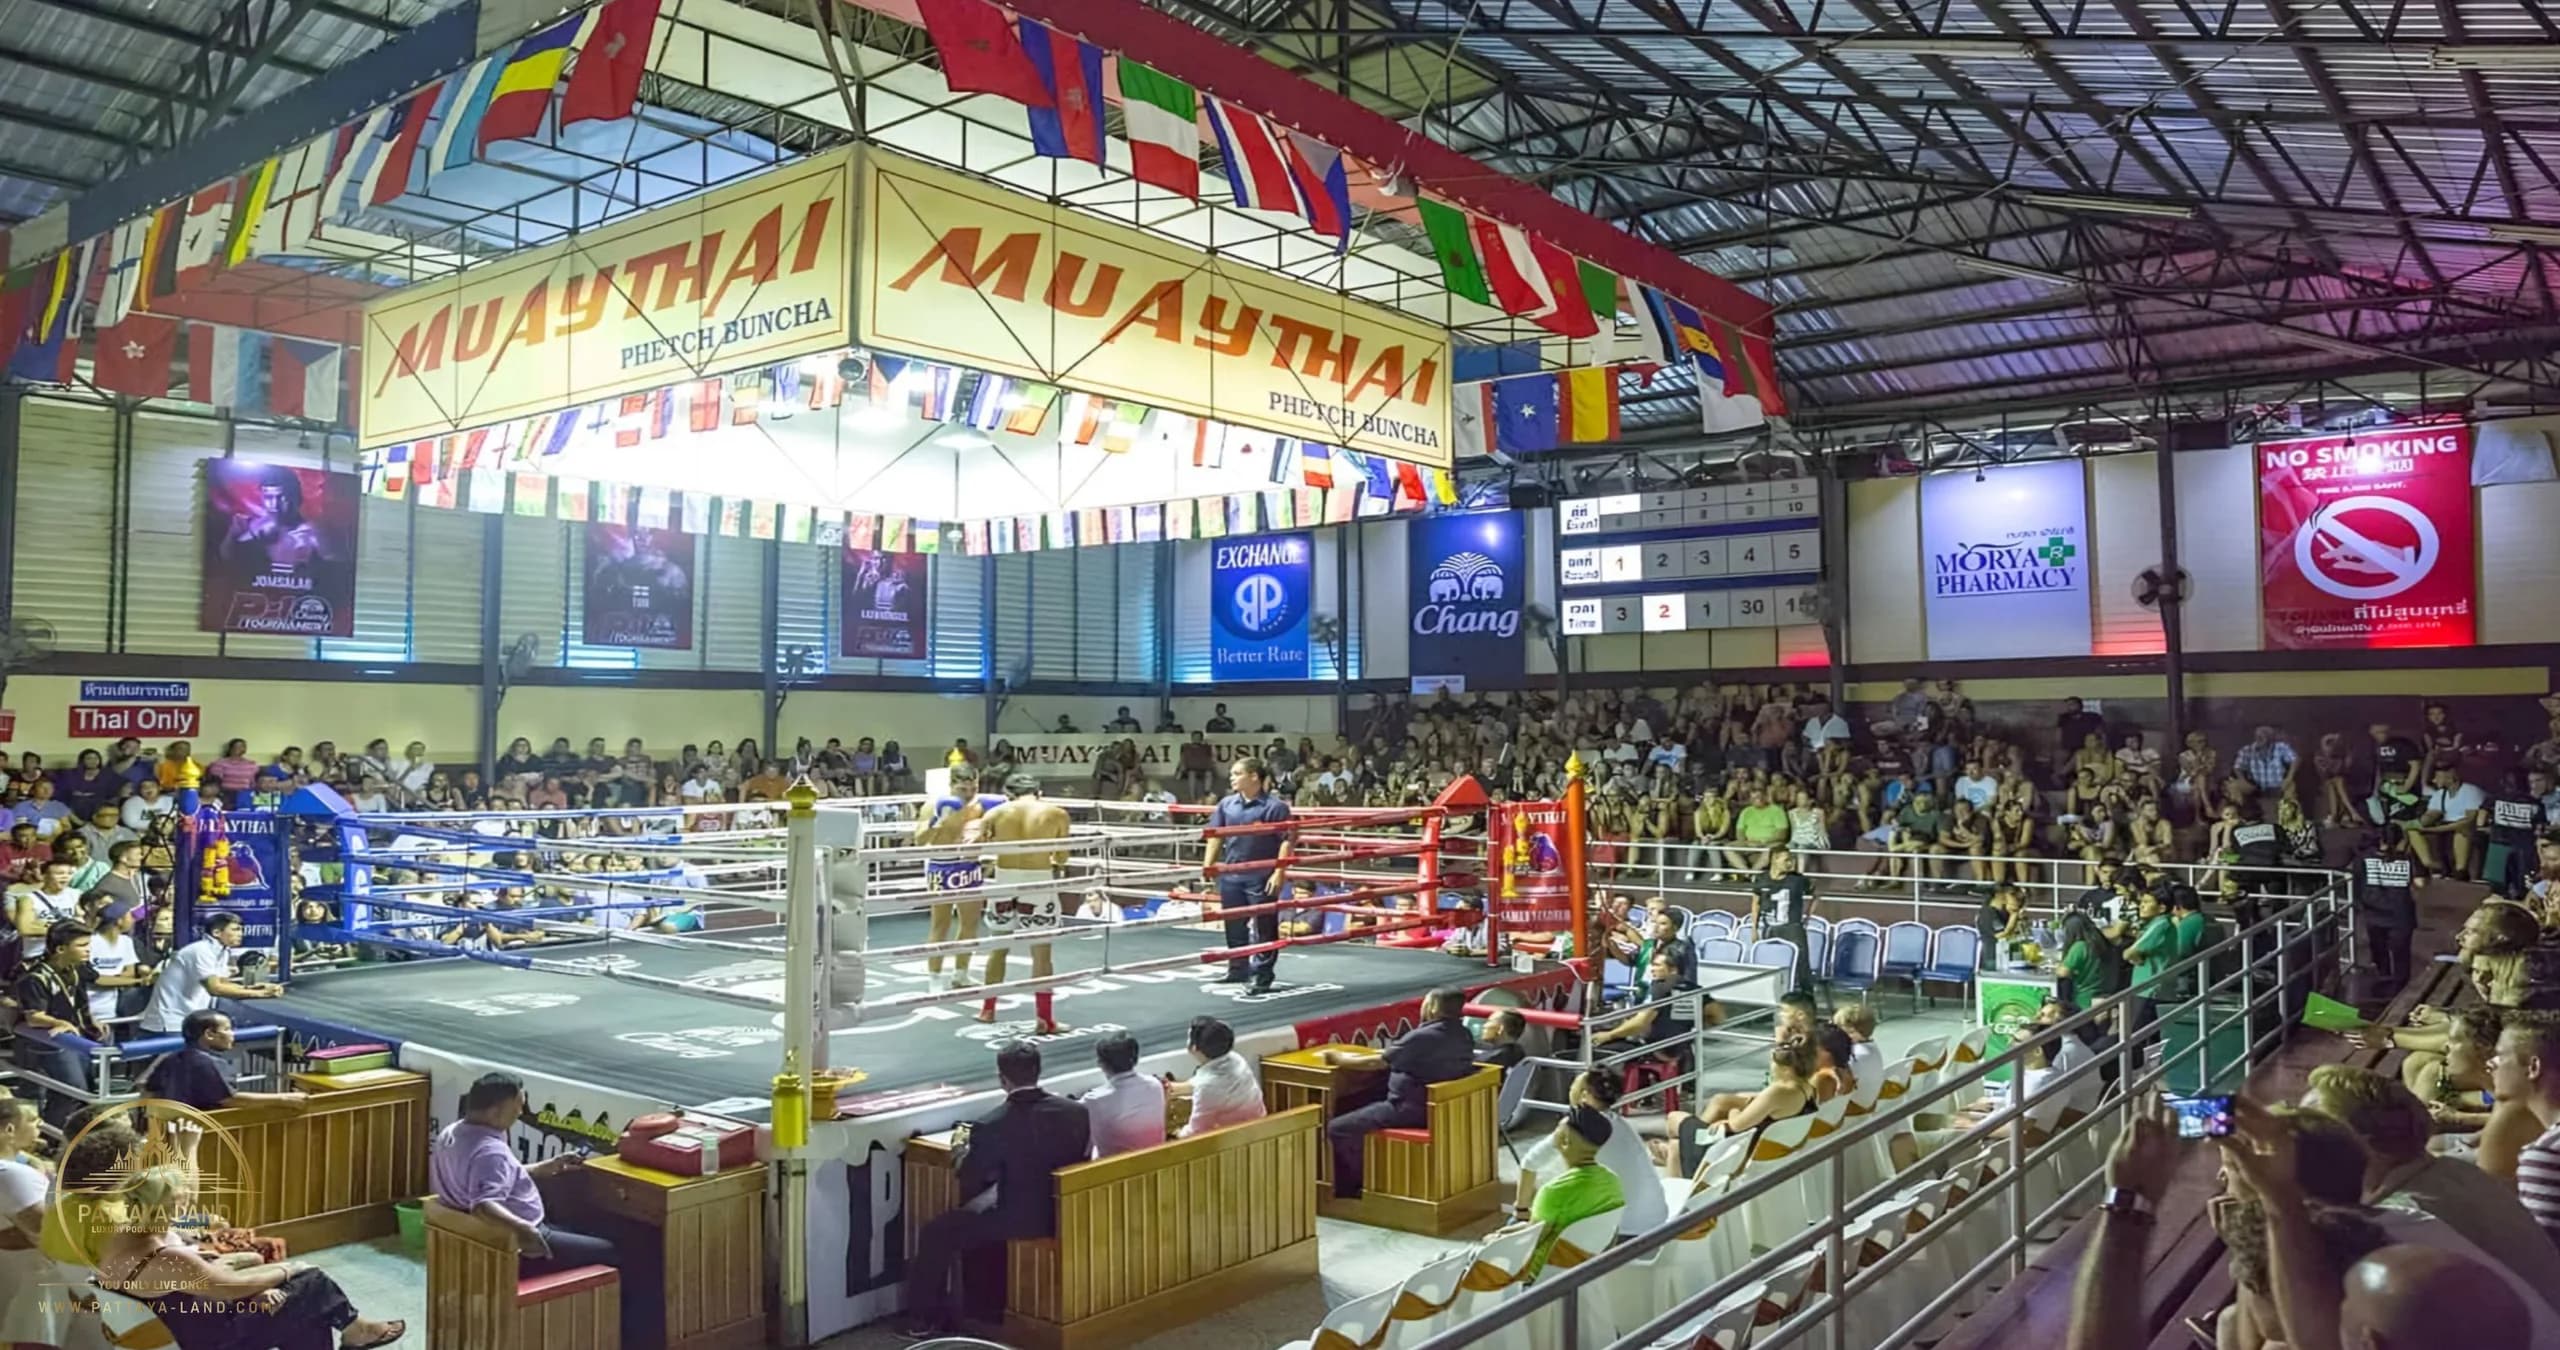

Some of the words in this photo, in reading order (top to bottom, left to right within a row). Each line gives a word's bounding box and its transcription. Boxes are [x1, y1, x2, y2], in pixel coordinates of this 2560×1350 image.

[621, 326, 714, 369] PHETCH
[722, 297, 832, 344] BUNCHA
[1269, 391, 1355, 429] PHETCH
[1362, 412, 1439, 448] BUNCHA
[2267, 449, 2309, 468] NO
[2316, 436, 2457, 463] SMOKING
[1789, 502, 1804, 512] 10
[1616, 557, 1624, 572] 1
[1657, 554, 1669, 568] 2
[1699, 550, 1710, 565] 3
[1744, 547, 1755, 562] 4
[1789, 544, 1800, 560] 5
[1936, 547, 2040, 575] MORYA
[1937, 567, 2076, 595] PHARMACY
[1413, 604, 1519, 637] Chang
[1616, 607, 1628, 621] 3
[1659, 604, 1671, 619] 2
[1703, 602, 1711, 617] 1
[1741, 599, 1764, 614] 30
[75, 708, 129, 730] Thai
[137, 708, 194, 734] Only
